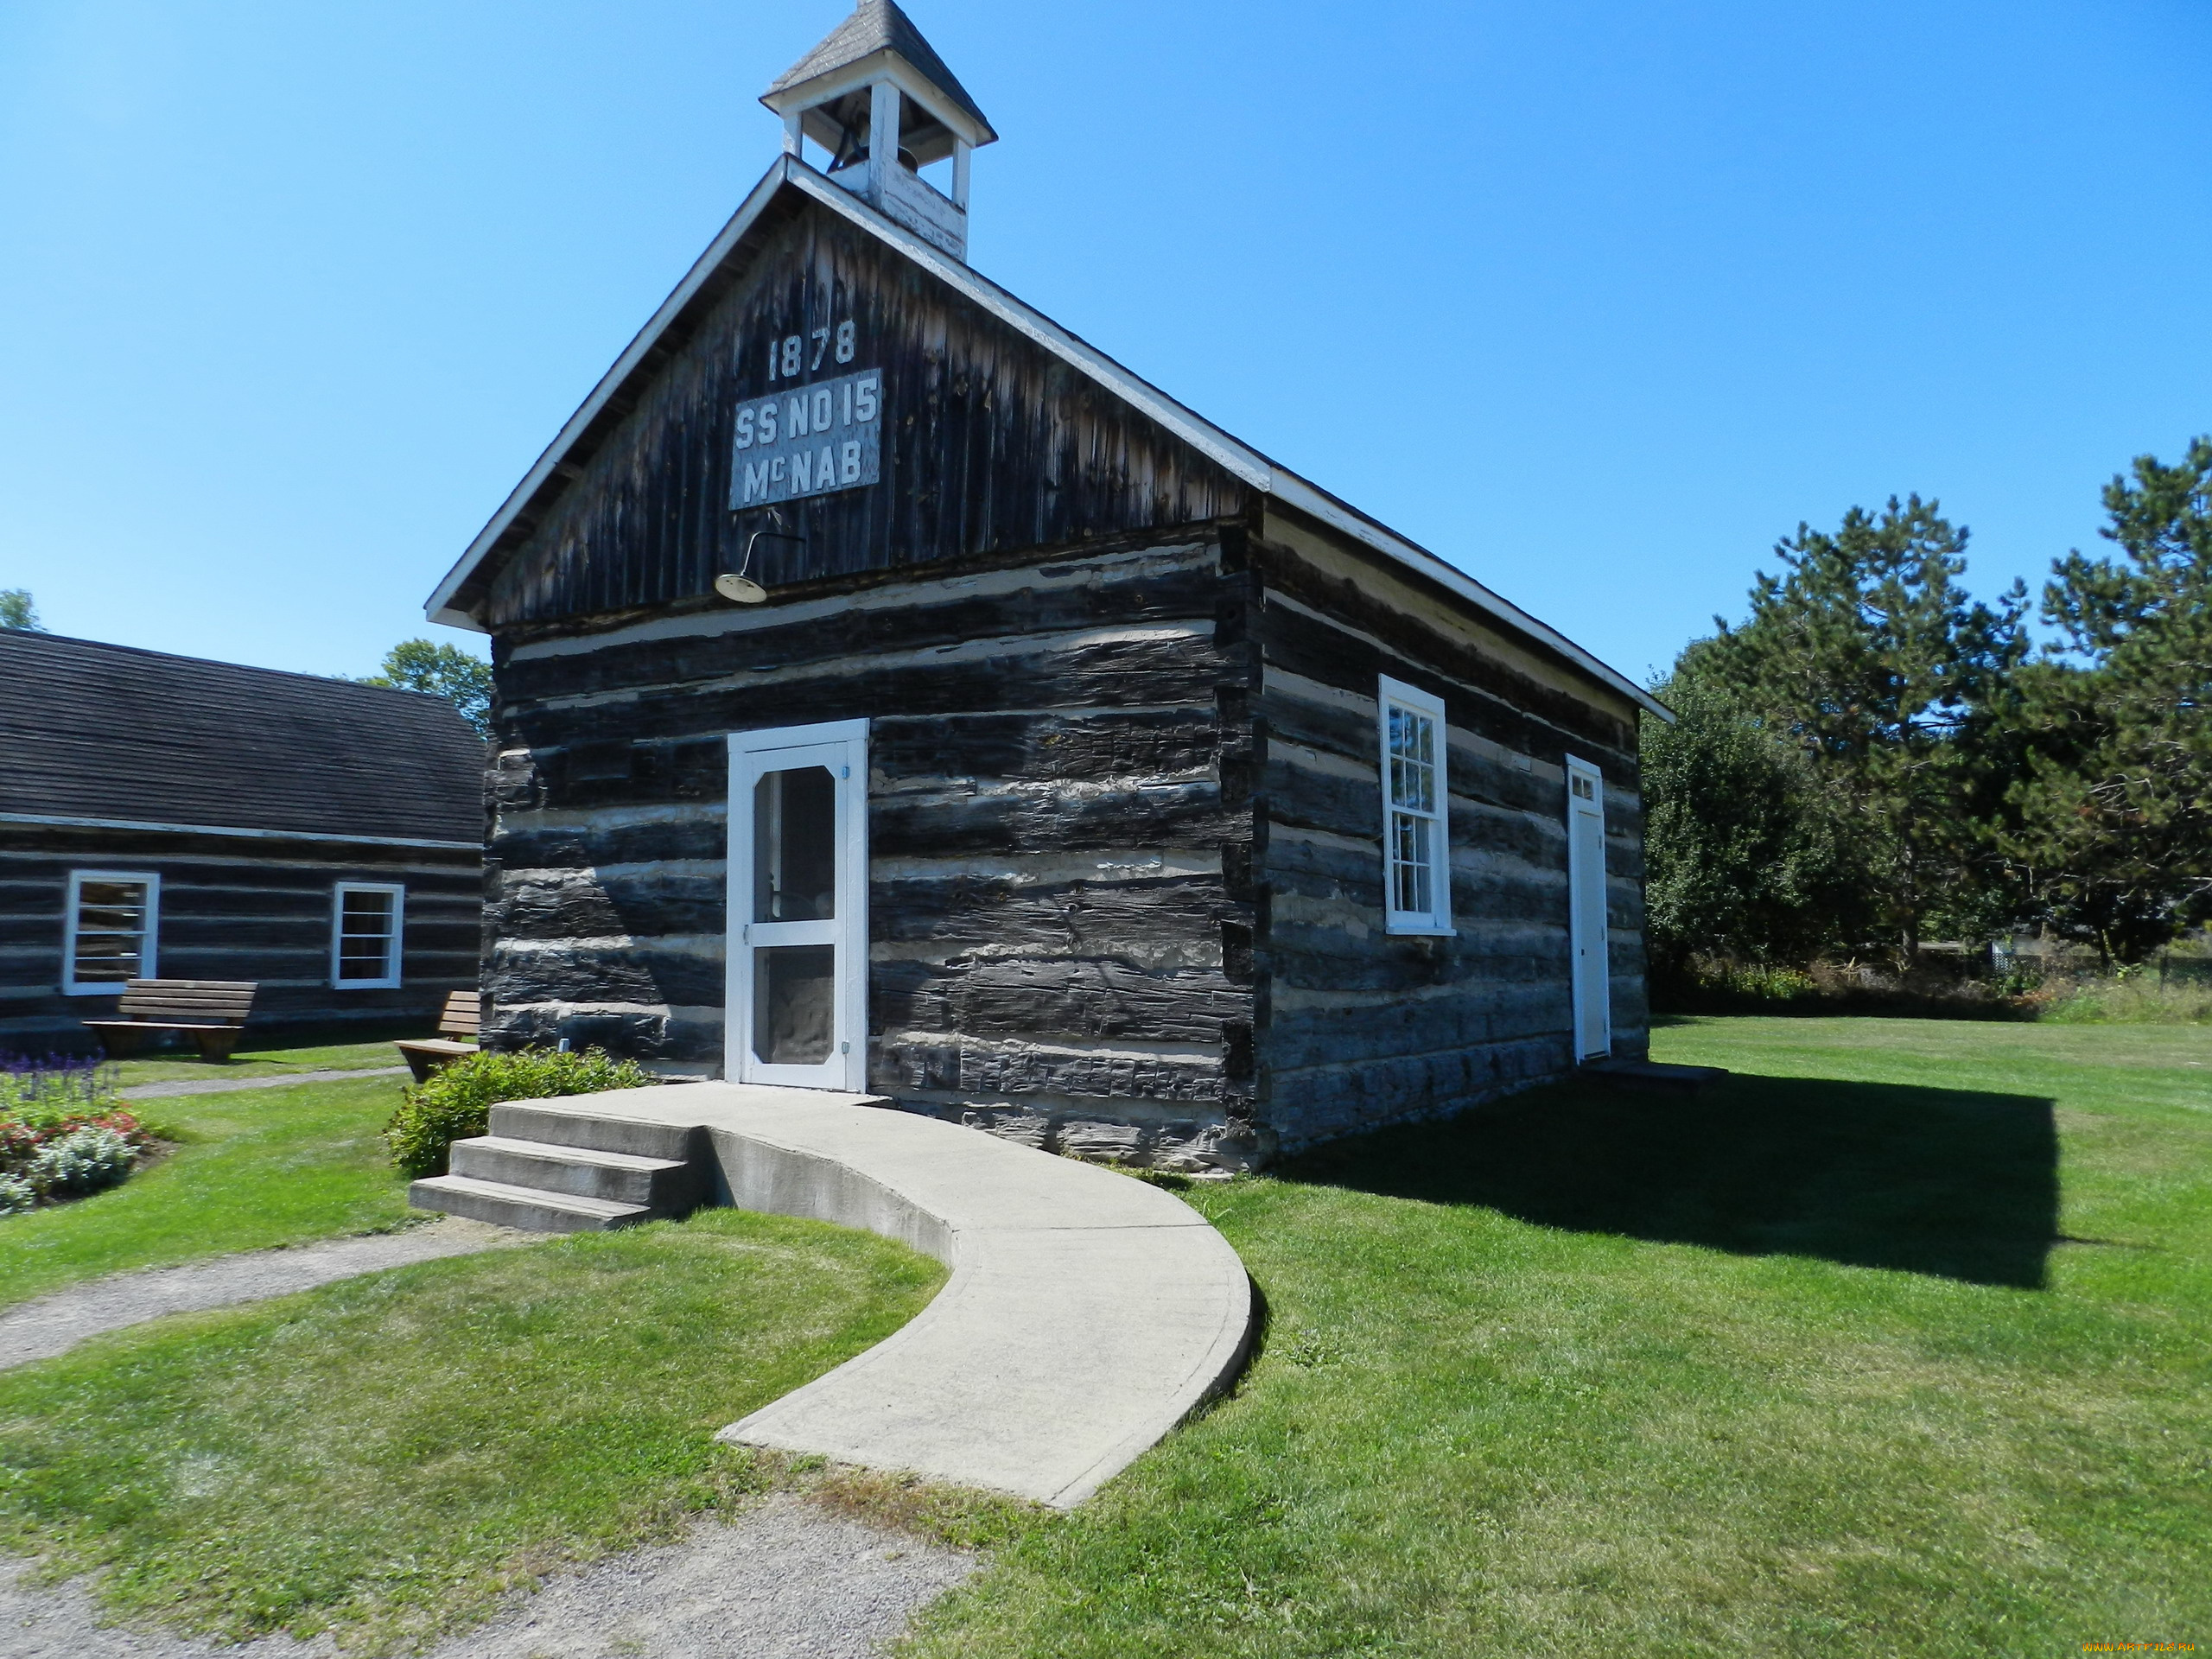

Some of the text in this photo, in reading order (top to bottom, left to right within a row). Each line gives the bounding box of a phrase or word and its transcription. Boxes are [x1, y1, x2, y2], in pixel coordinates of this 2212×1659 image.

[769, 320, 855, 382] 1878
[735, 378, 878, 449] SS NO 15
